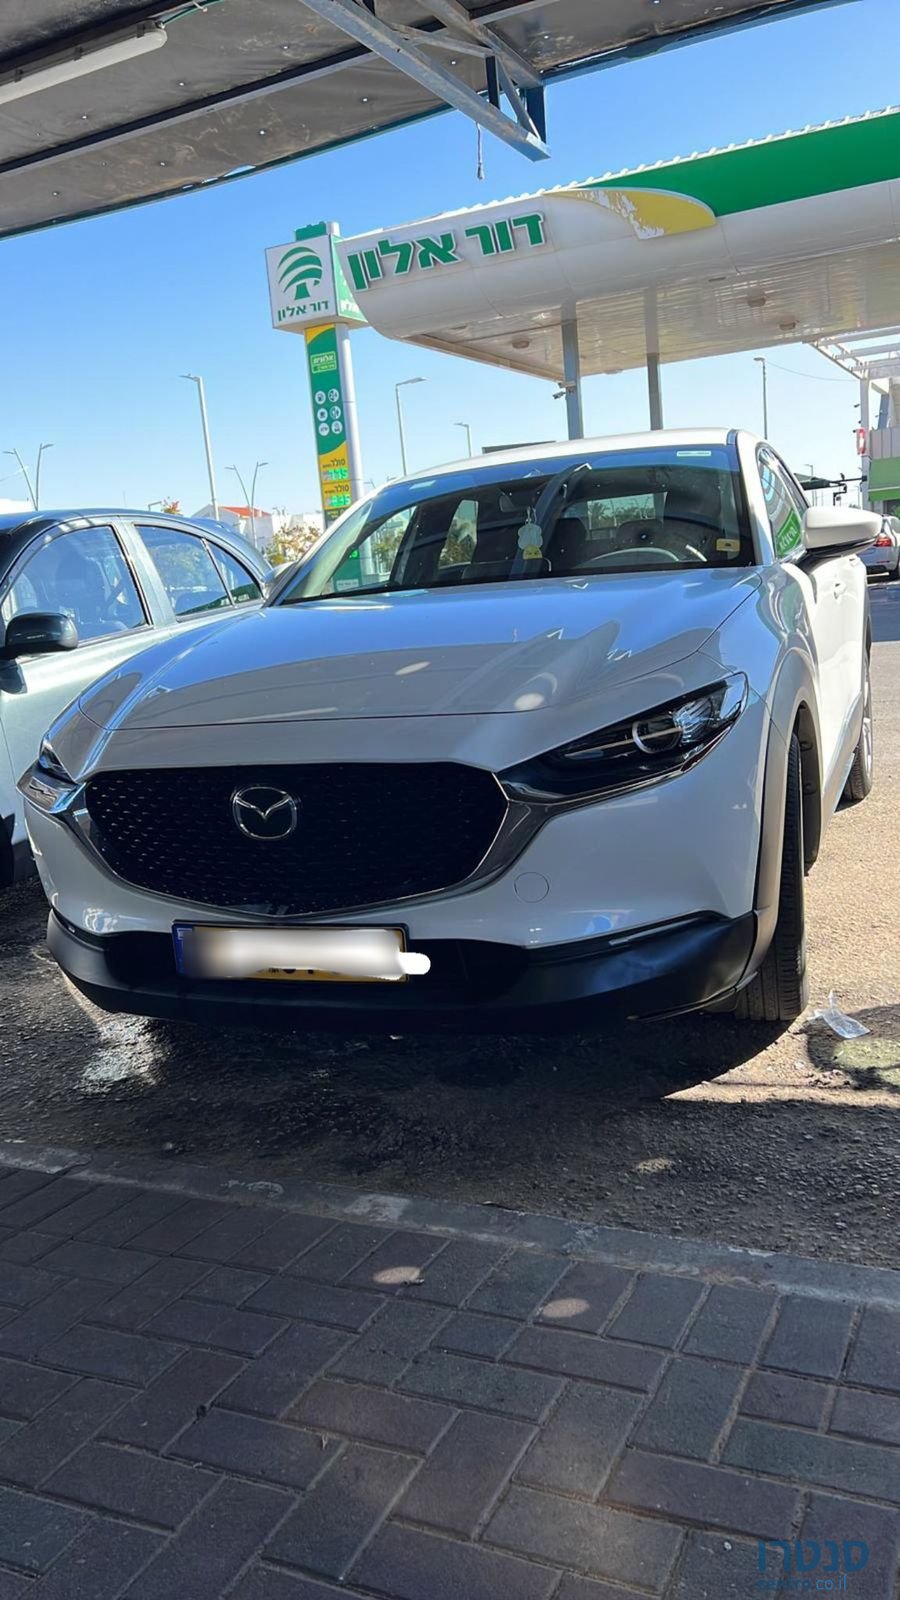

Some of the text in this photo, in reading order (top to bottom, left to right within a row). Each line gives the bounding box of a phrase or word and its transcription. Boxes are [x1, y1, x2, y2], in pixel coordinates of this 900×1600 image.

[347, 212, 545, 292] דור אלון
[277, 304, 307, 321] אלון
[309, 300, 328, 312] דור
